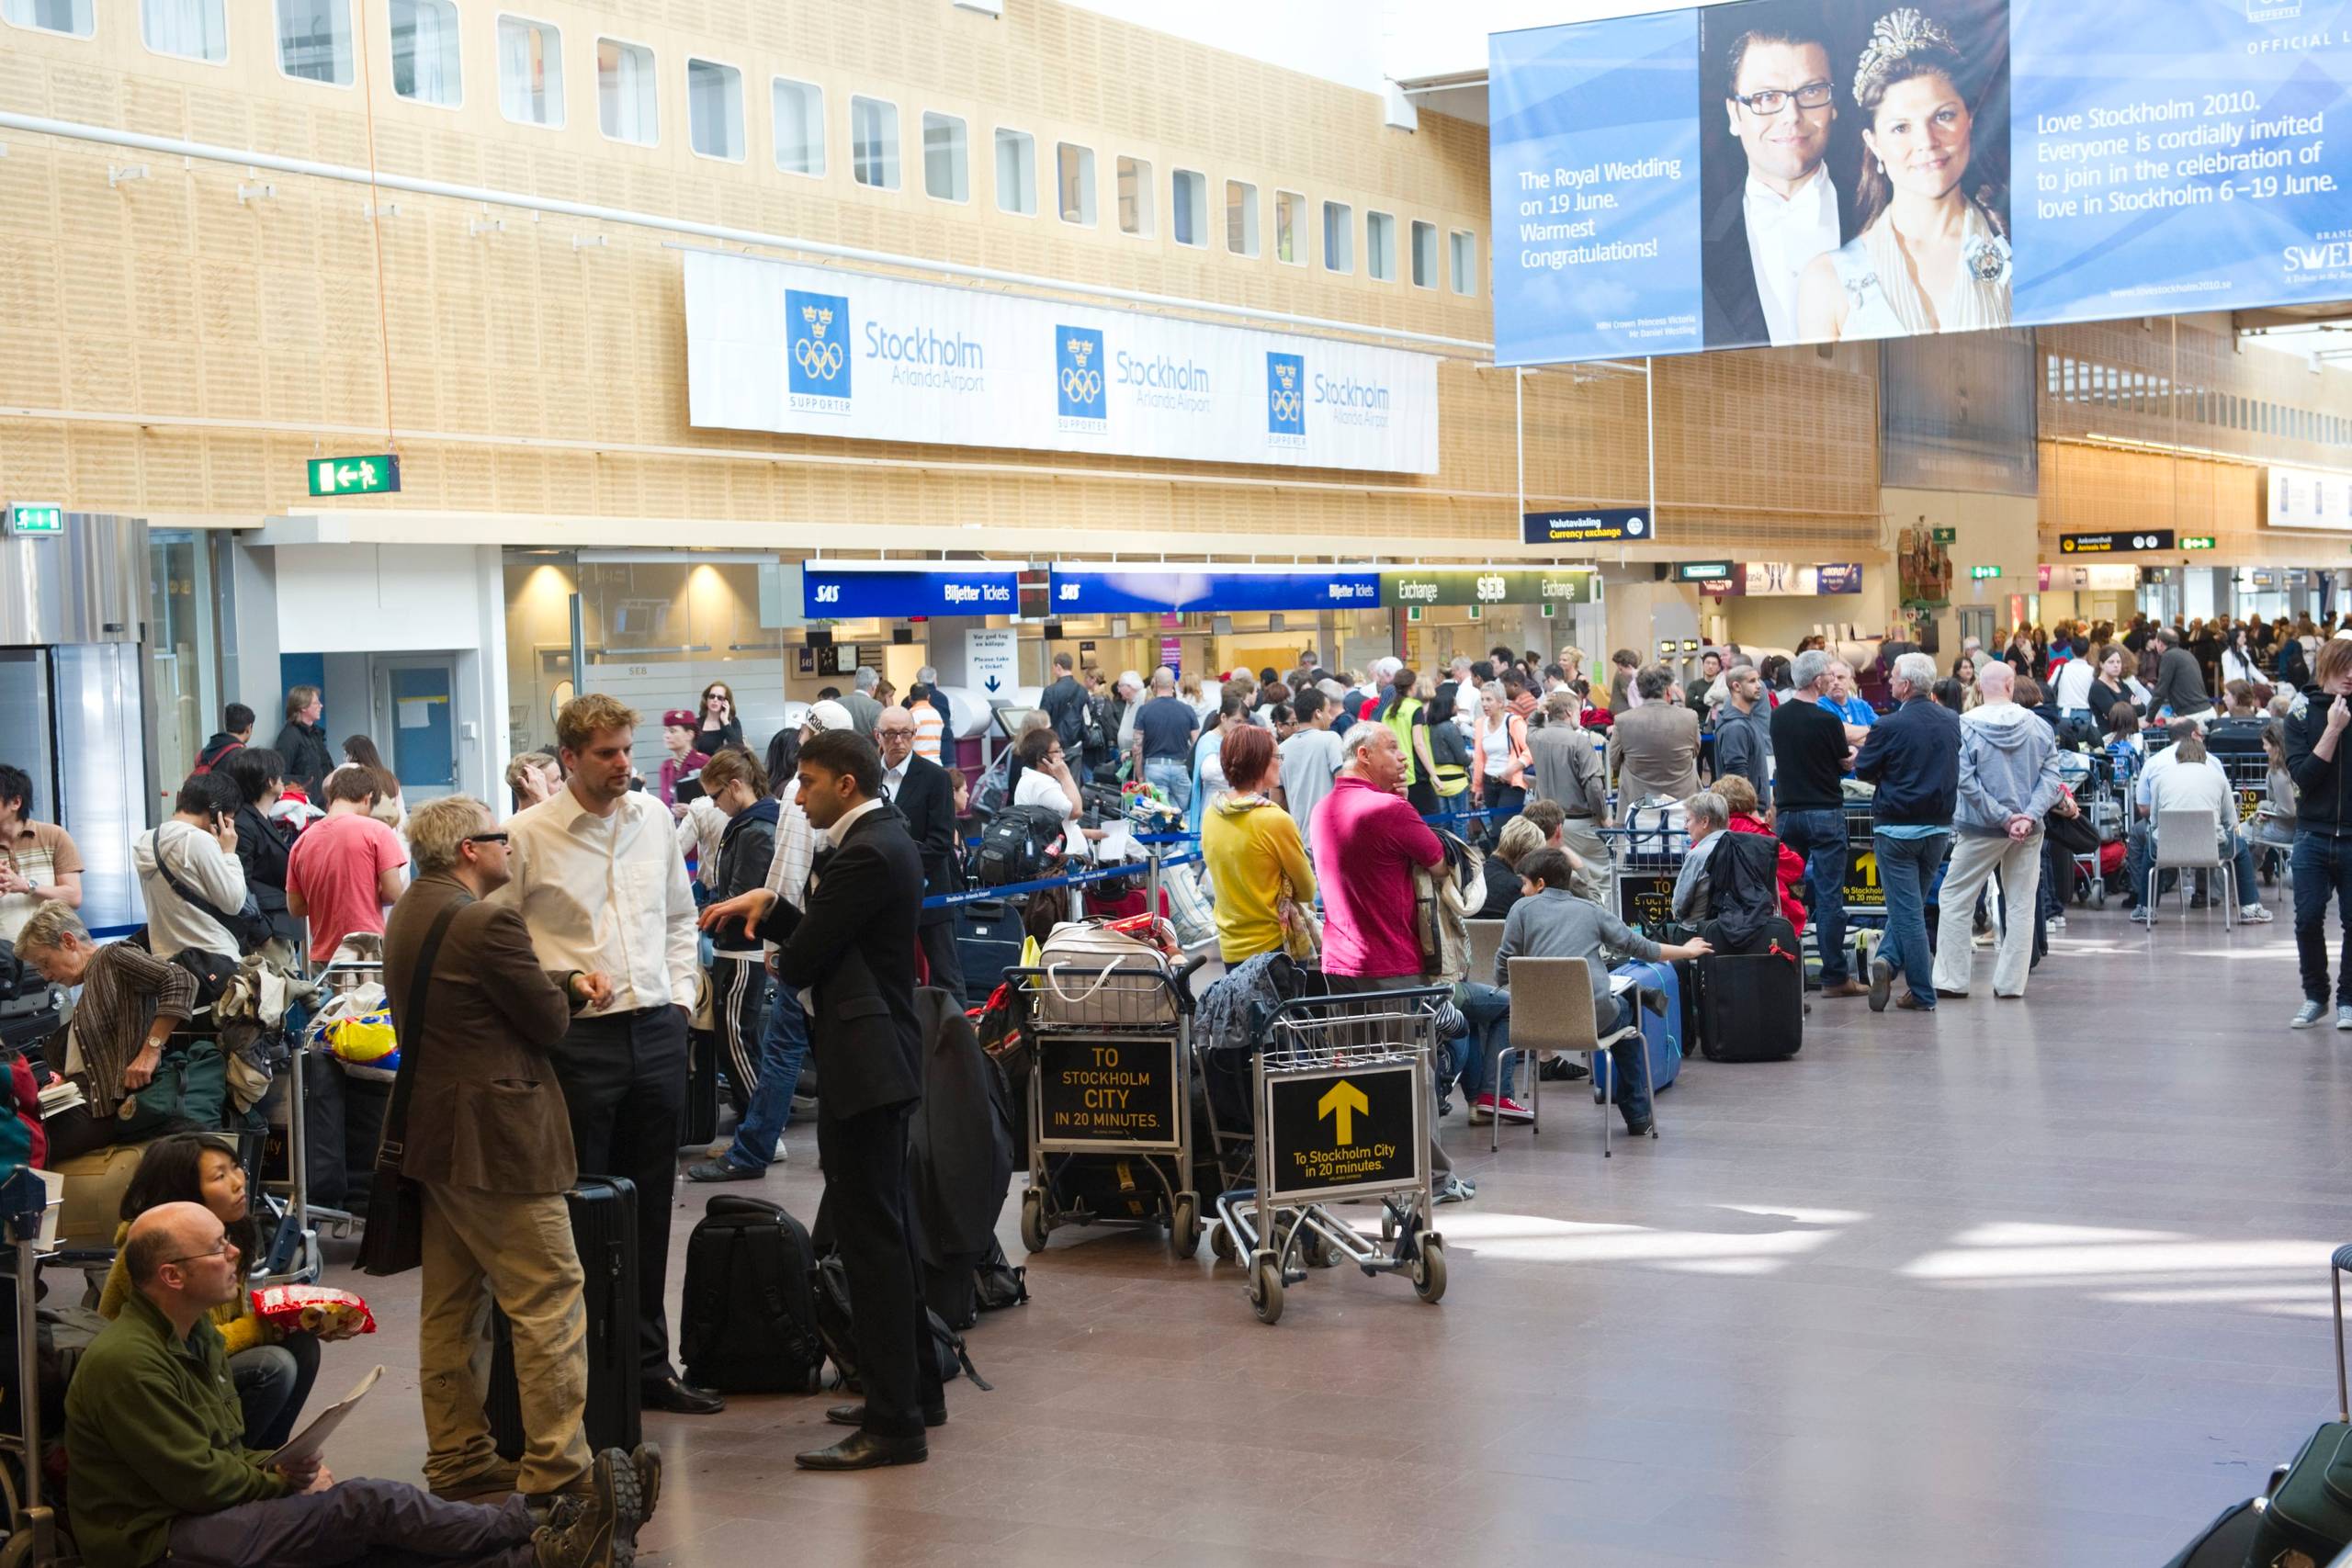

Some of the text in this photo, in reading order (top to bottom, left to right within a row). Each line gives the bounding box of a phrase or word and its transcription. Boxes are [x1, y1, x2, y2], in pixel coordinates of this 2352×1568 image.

[2247, 33, 2332, 55] OFFICIAL
[2038, 91, 2261, 135] Love Stockholm 2010.
[2038, 112, 2324, 164] Everyone is cordially invited
[1519, 158, 1682, 190] The Royal Wedding
[2037, 141, 2324, 193] to join in the celebration of
[1521, 193, 1619, 217] on 19 June.
[2038, 197, 2077, 220] love
[2084, 194, 2102, 214] in
[2109, 184, 2213, 213] Stockholm
[2282, 173, 2338, 197] June.
[1521, 219, 1596, 243] Warmest
[1521, 238, 1658, 270] Congratulations!
[2109, 280, 2233, 299] www.lovestockholm2010.se
[865, 321, 984, 370] Stockholm
[891, 365, 985, 395] Arlanda Airport
[1116, 350, 1210, 393] Stockholm
[1136, 389, 1211, 413] Arlanda Airport
[1314, 373, 1390, 411] Stockholm
[789, 396, 852, 412] SUPPORTER
[1549, 517, 1602, 530] Valutaväxling
[1549, 527, 1623, 540] Currency exchange
[814, 584, 841, 603] SAS
[944, 584, 980, 604] Biljetter
[981, 584, 1011, 602] Tickets
[1058, 583, 1081, 601] SAS
[1329, 583, 1374, 600] Biljetter Tickets
[1398, 580, 1438, 602] Exchange
[1542, 579, 1575, 599] Exchange
[628, 666, 648, 676] SEB
[800, 658, 813, 668] SAS
[1653, 881, 1671, 894] TO
[1848, 894, 1856, 902] in
[1866, 894, 1886, 902] minu
[1091, 1047, 1119, 1067] TO
[1062, 1071, 1150, 1086] STOCKHOLM
[1084, 1089, 1130, 1110] CITY
[1055, 1111, 1160, 1128] IN 20 MINUTES.
[266, 1139, 282, 1156] ity
[1293, 1144, 1396, 1166] To Stockholm City
[1306, 1160, 1385, 1179] in 20 minutes.
